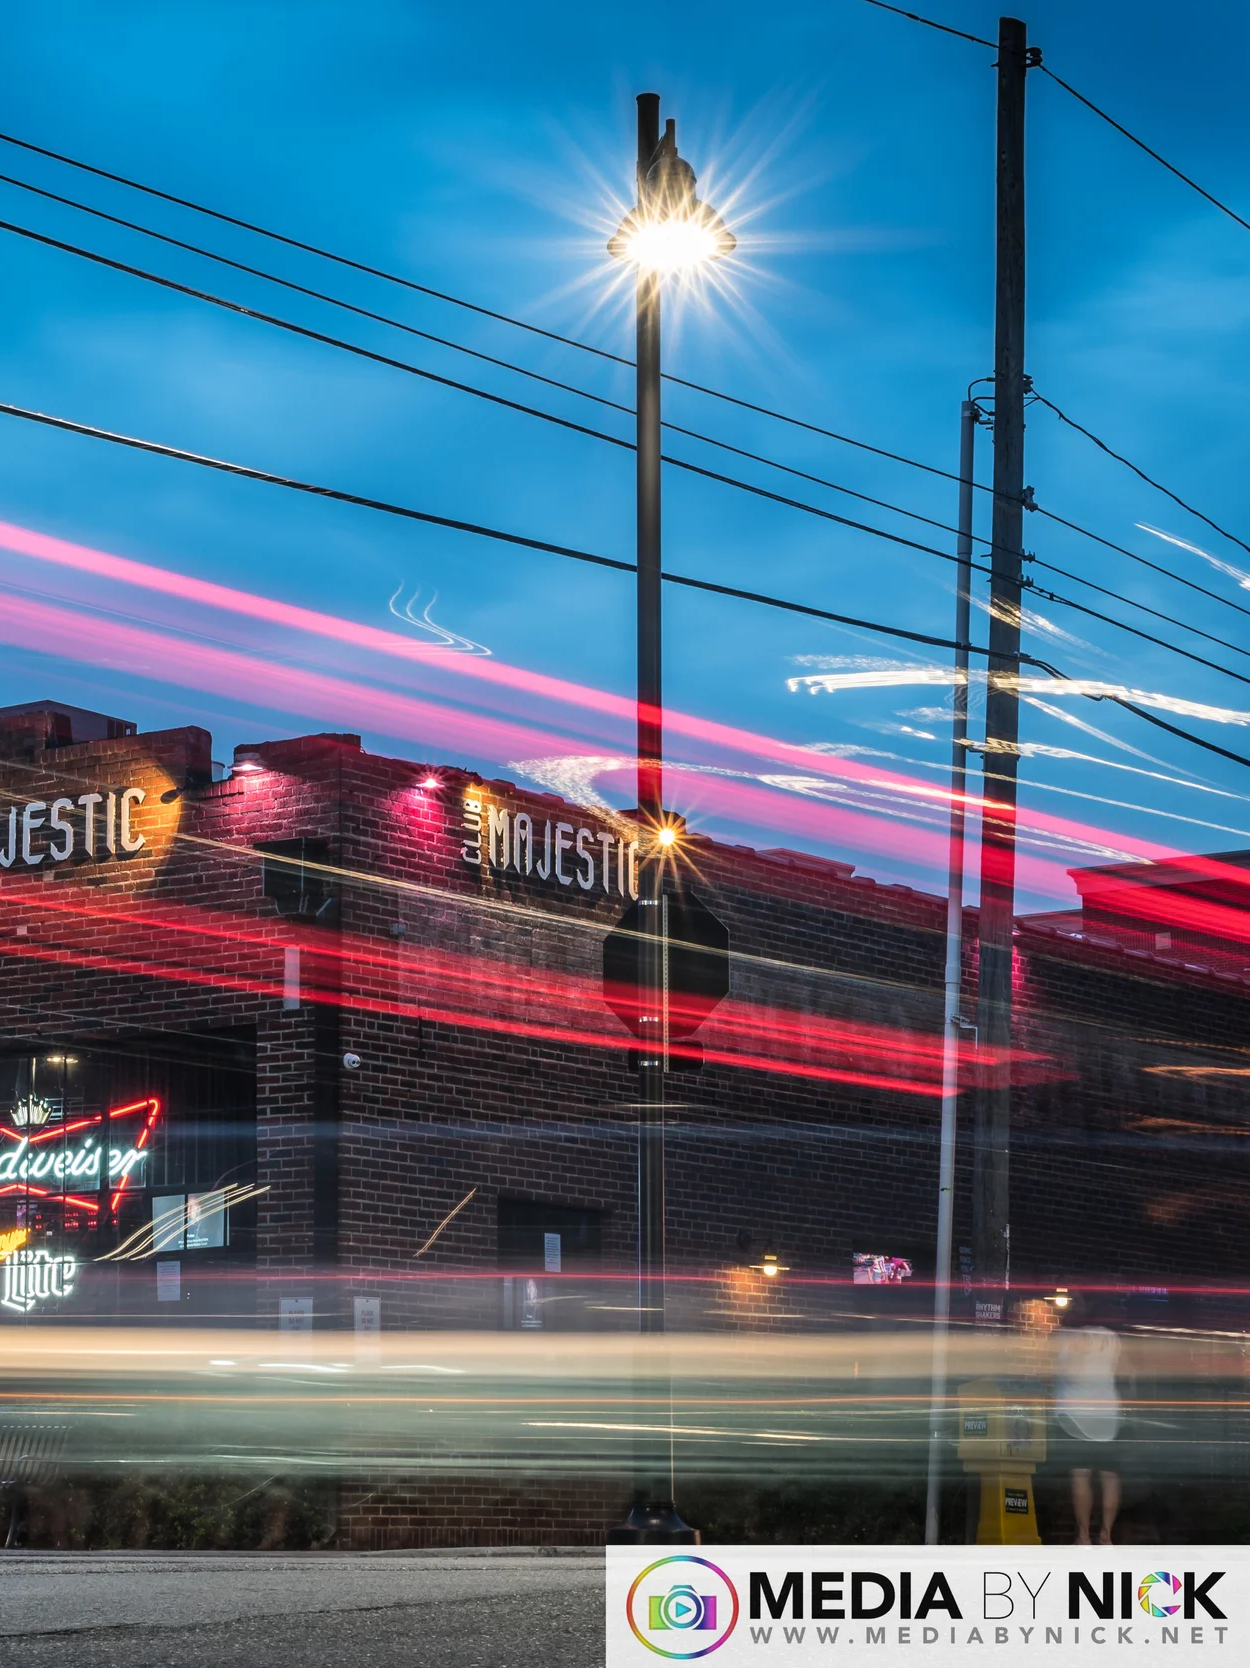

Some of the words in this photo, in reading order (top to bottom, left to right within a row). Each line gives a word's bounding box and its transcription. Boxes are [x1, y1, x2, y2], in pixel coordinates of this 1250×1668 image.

[461, 800, 482, 865] CLUB
[1, 1249, 75, 1311] Lite
[975, 1303, 1002, 1312] RHYTHM
[975, 1311, 1002, 1320] SHAKERS
